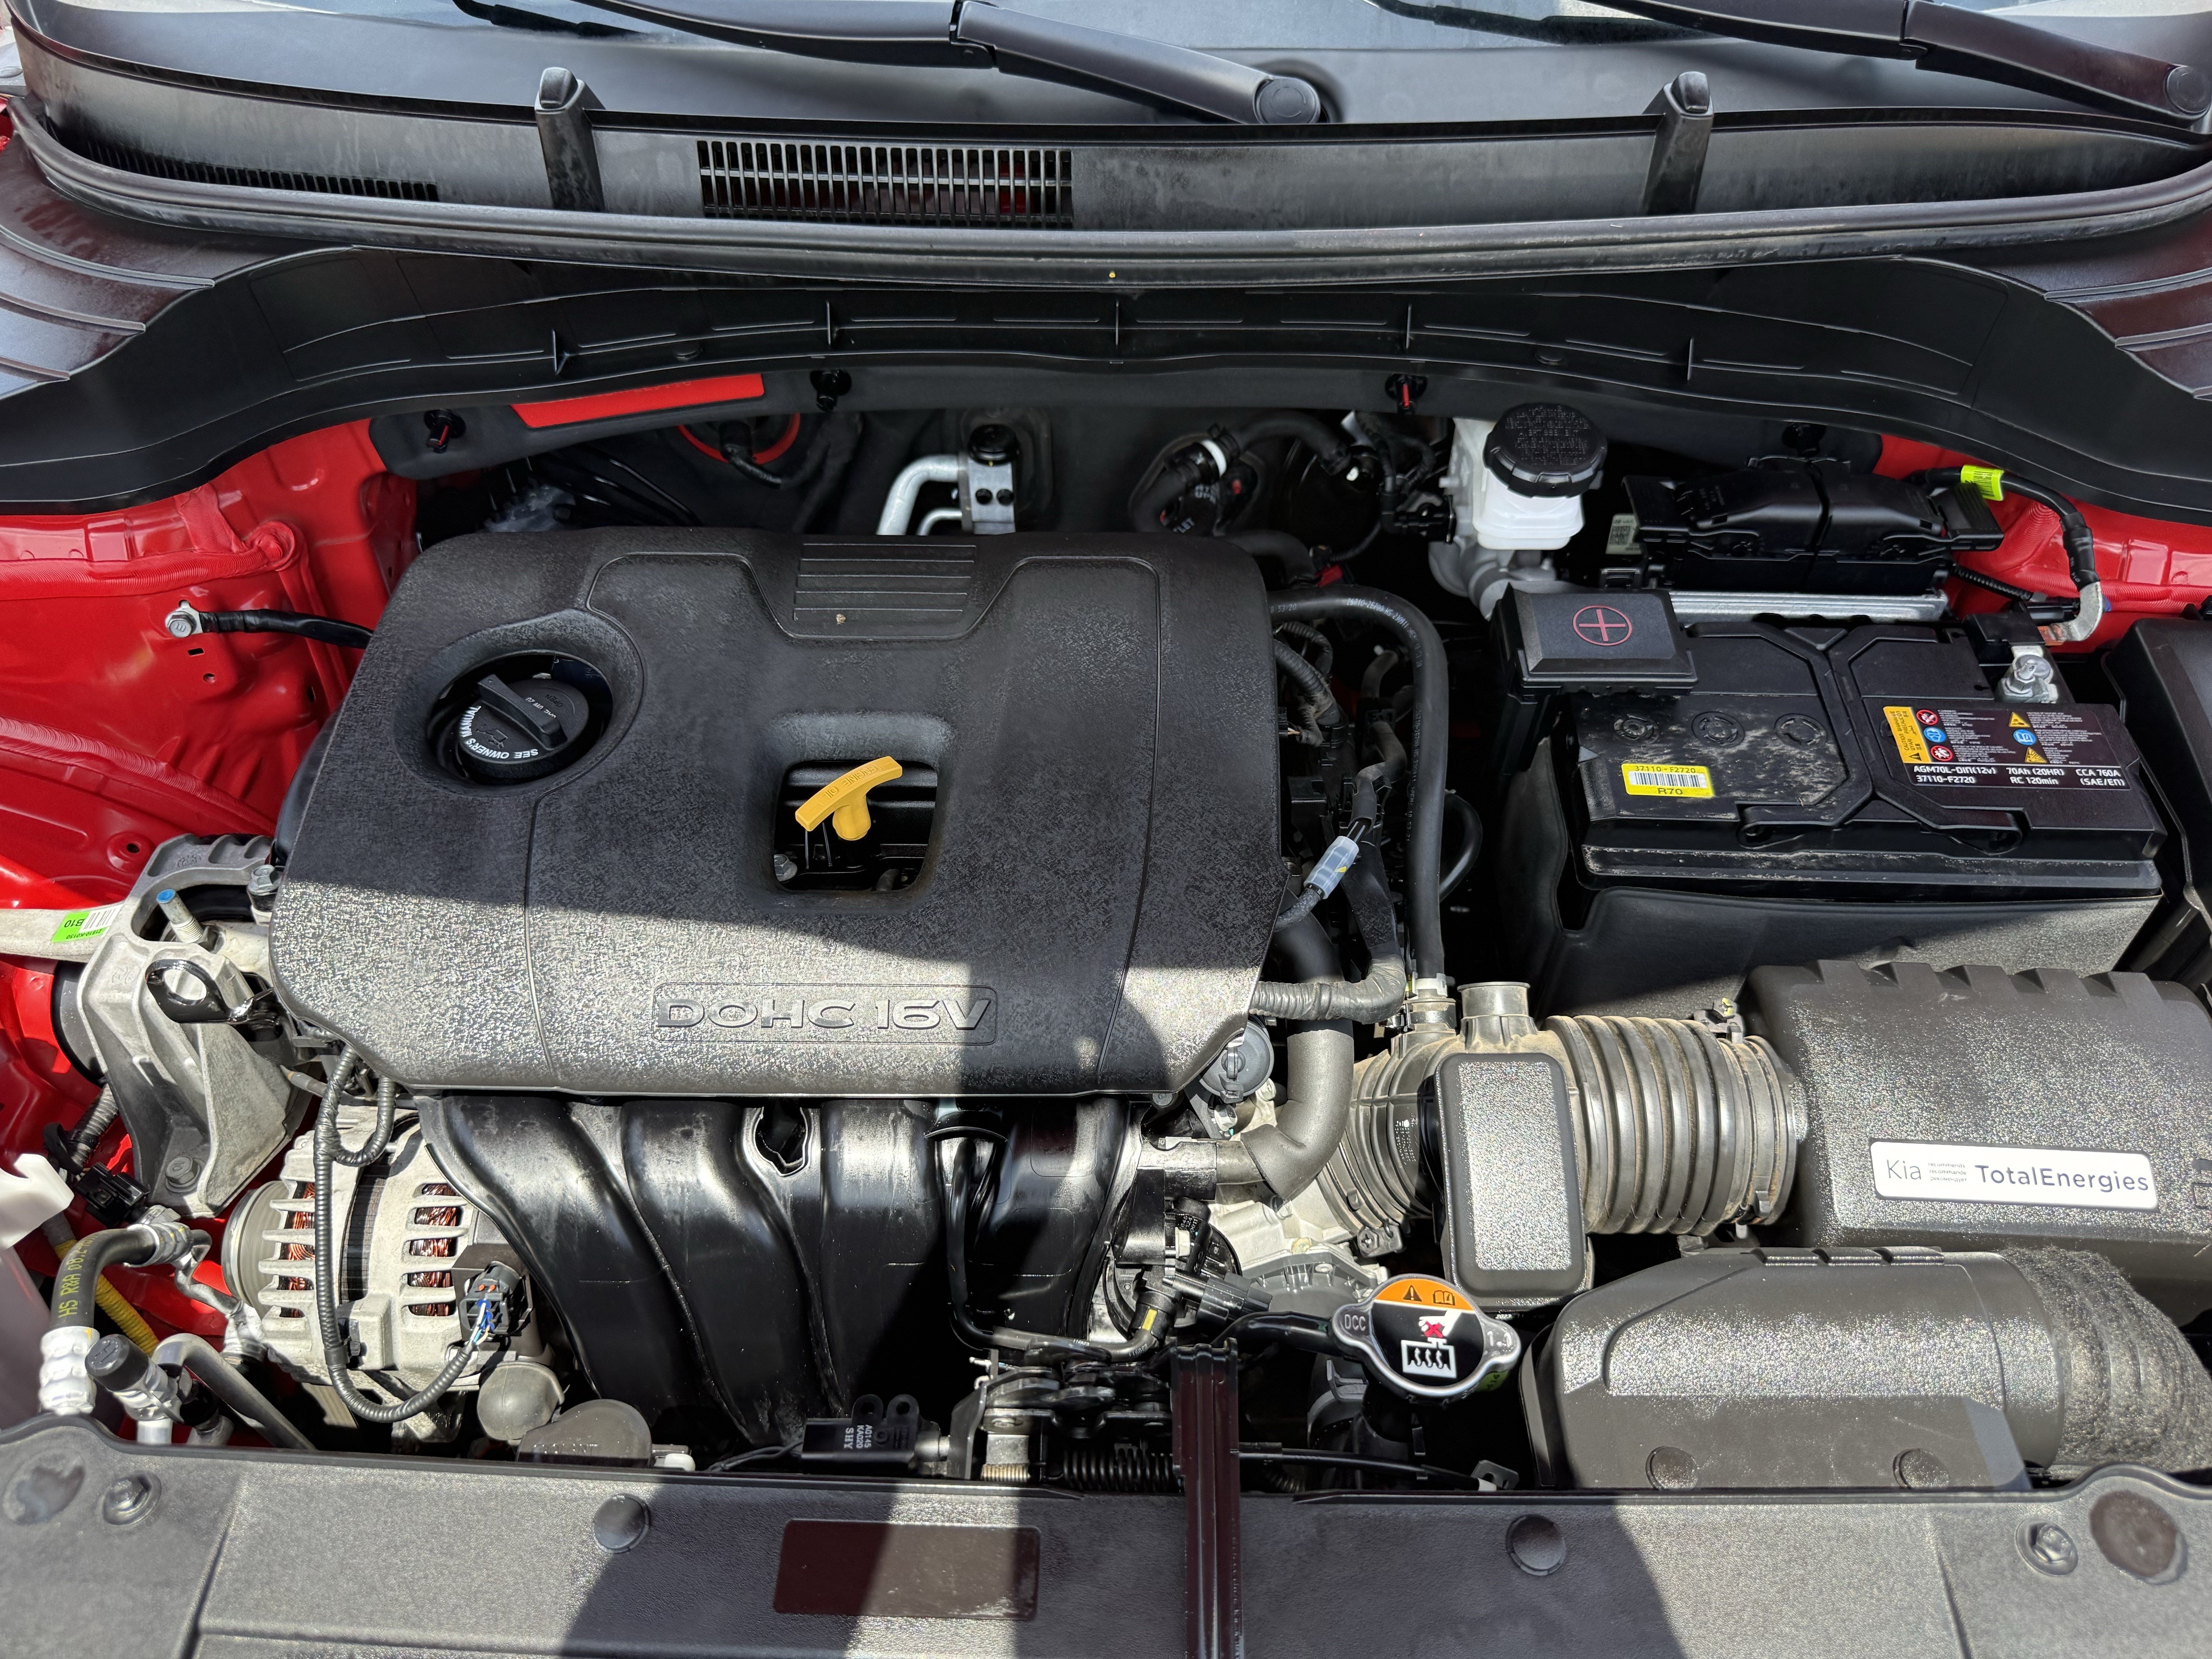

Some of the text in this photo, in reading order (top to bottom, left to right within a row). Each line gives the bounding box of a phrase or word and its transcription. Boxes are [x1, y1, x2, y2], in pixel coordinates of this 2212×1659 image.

[544, 694, 564, 708] OPEN
[459, 705, 539, 759] SEE OWNER'S MANUAL
[820, 765, 877, 799] ENGINE OIL
[1916, 775, 1975, 784] 37110-F2720
[2006, 767, 2065, 776] 70Ah (20HR)
[2010, 776, 2059, 785] RC 120min
[2096, 769, 2121, 777] 760A
[64, 919, 86, 928] B10
[657, 998, 992, 1030] DOHC 16V
[1886, 1159, 1922, 1181] Kia
[1974, 1164, 2149, 1192] TotalEnergies
[61, 1273, 81, 1297] R&A
[58, 1299, 78, 1319] HS
[1345, 1314, 1366, 1331] DCC
[843, 1427, 854, 1449] SHY
[856, 1424, 864, 1449] KA020
[864, 1424, 873, 1449] A0145
